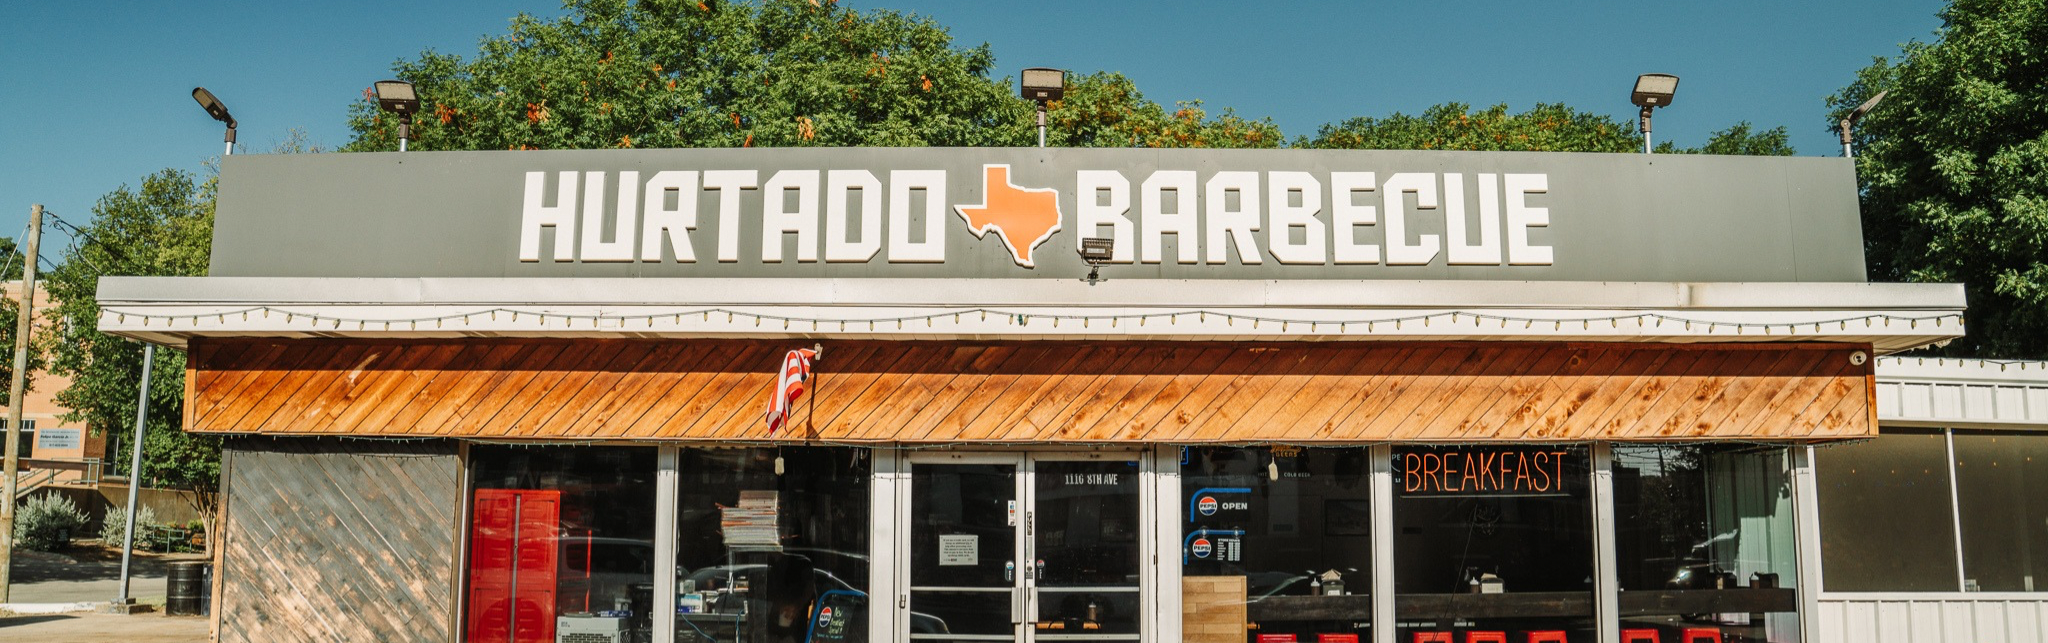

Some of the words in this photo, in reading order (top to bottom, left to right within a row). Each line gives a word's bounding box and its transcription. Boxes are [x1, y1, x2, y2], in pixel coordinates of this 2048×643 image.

[519, 169, 947, 263] HURTADO
[1076, 170, 1554, 265] BARBECUE
[1065, 474, 1084, 485] 1116
[1087, 474, 1102, 485] 8TH
[1103, 474, 1118, 485] AVE
[1405, 451, 1568, 492] BREAKFAST
[1222, 502, 1248, 510] OPEN
